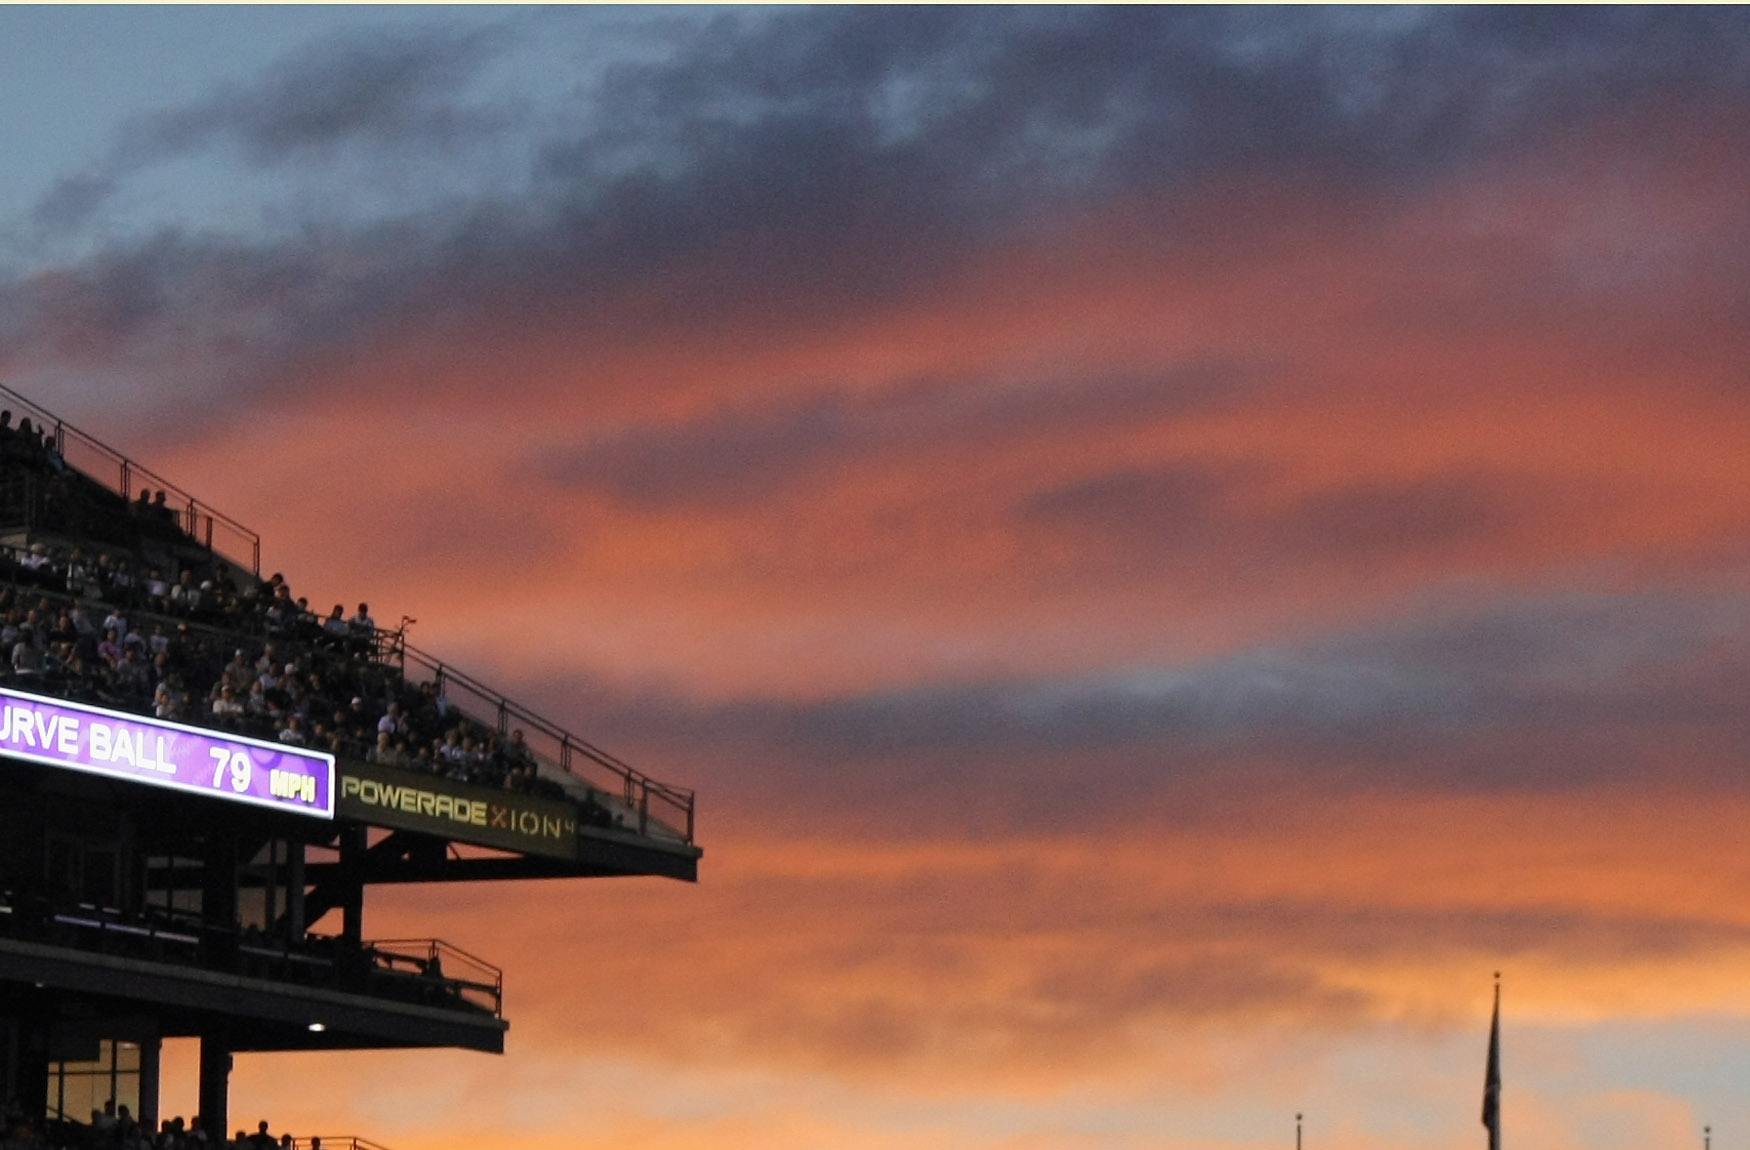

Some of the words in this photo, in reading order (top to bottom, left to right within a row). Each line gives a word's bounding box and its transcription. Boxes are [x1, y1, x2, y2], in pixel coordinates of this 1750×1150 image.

[89, 722, 177, 775] BALL
[209, 746, 251, 793] 79
[270, 769, 316, 804] MPH
[341, 775, 488, 826] POWERADE
